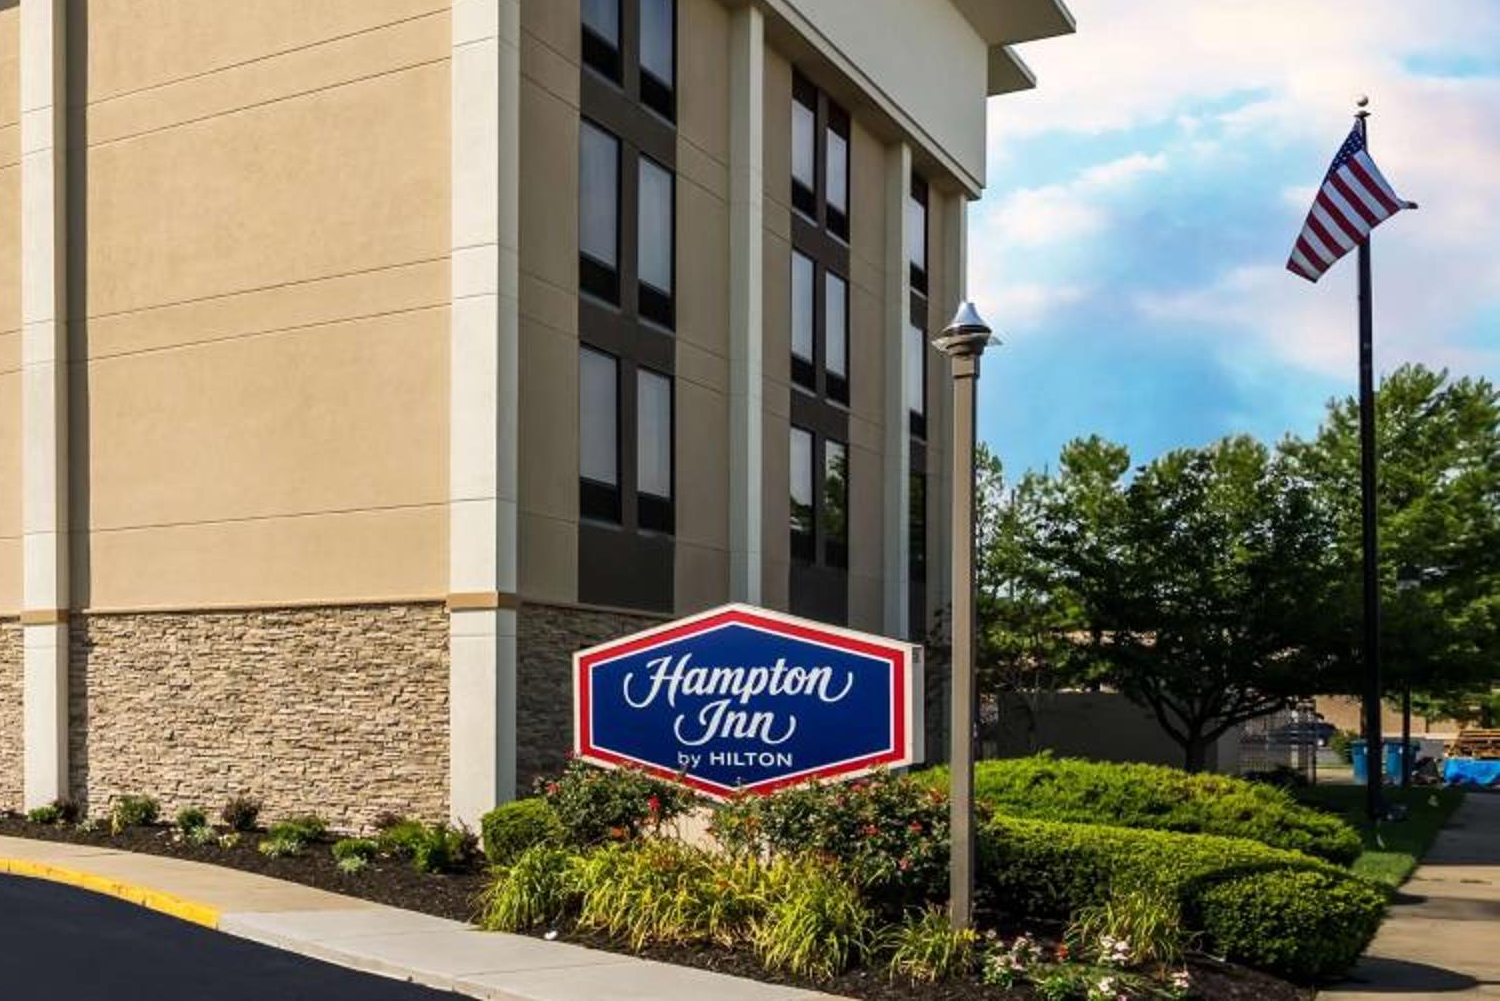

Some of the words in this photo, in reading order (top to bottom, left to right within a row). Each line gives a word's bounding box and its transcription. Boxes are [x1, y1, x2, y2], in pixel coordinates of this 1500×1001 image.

[623, 652, 853, 708] Hampton
[674, 699, 797, 746] Inn
[678, 752, 701, 768] by
[710, 752, 793, 767] HILTON
